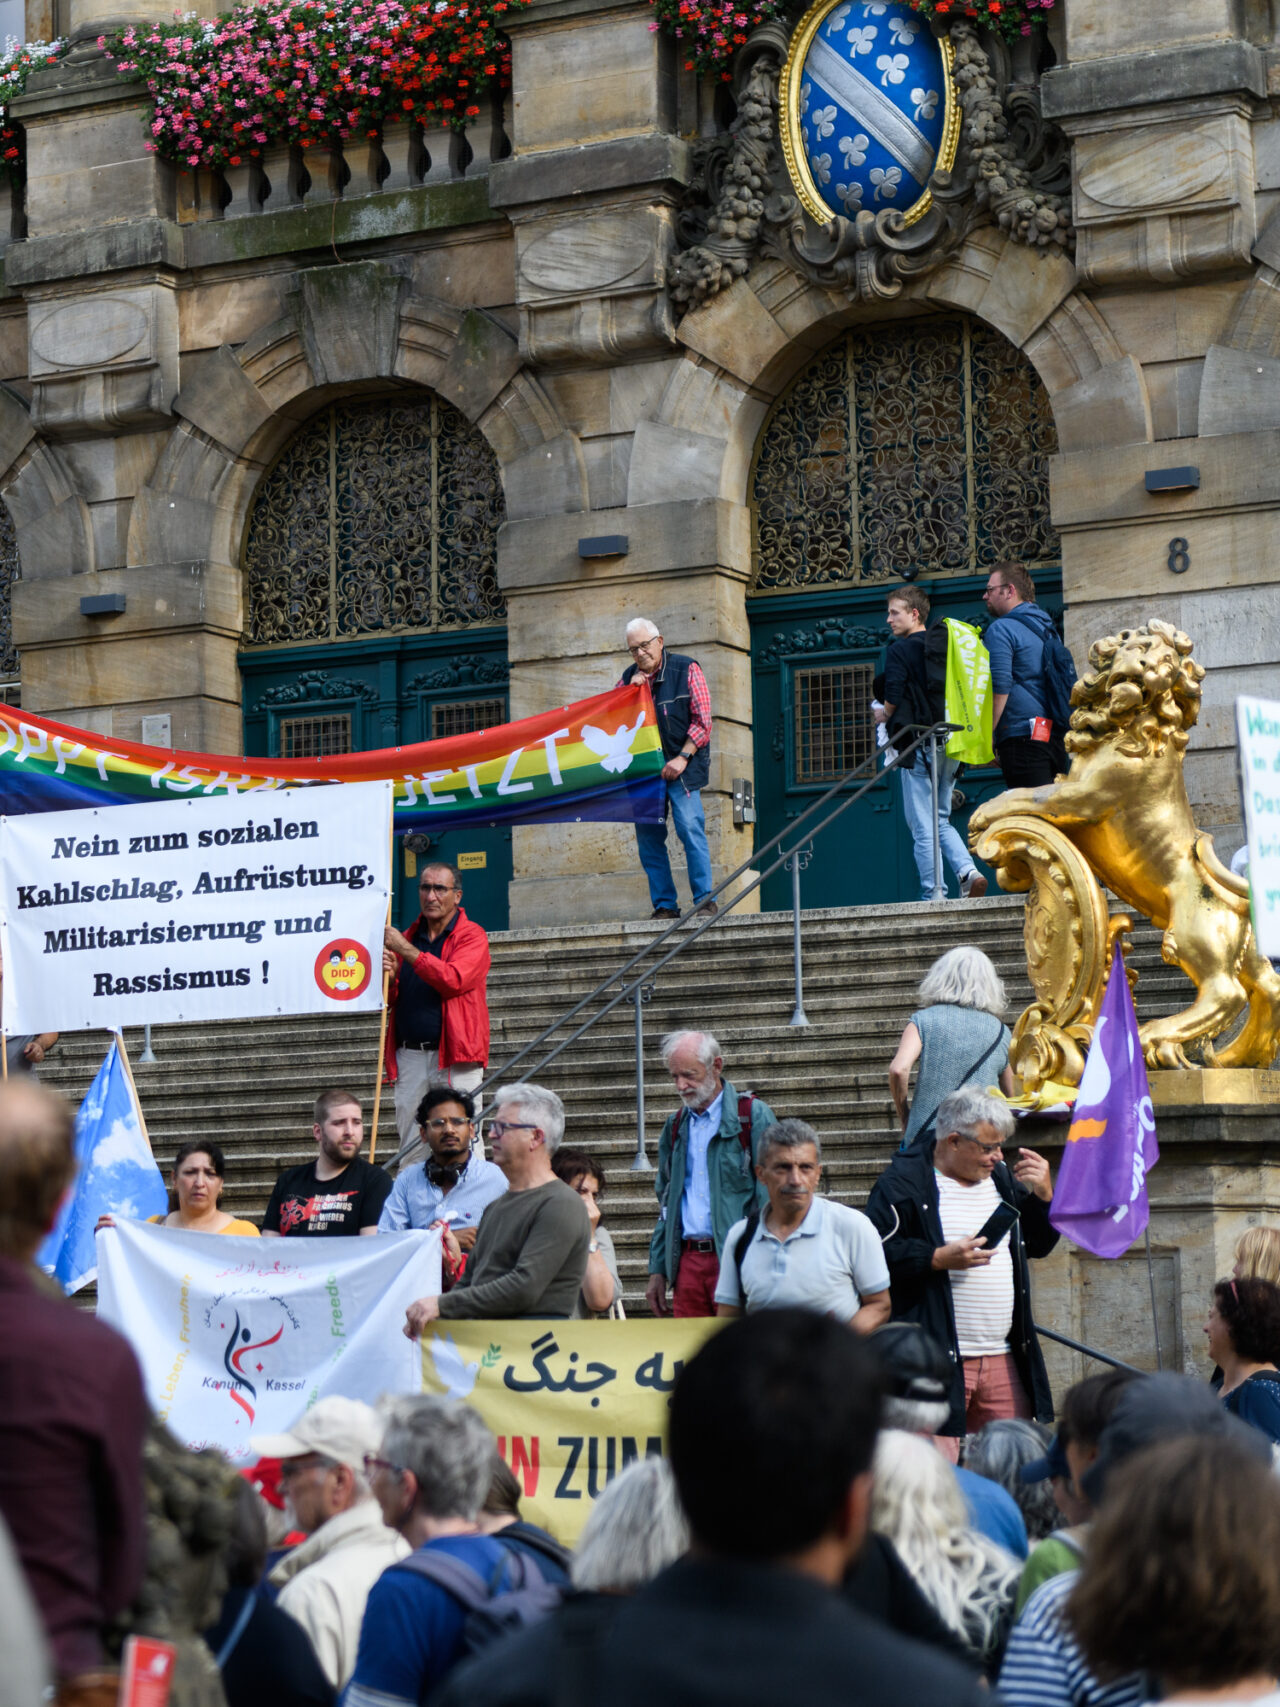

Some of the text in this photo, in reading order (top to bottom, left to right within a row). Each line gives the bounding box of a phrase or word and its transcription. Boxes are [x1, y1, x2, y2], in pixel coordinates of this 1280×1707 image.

[1168, 537, 1190, 574] 8
[151, 760, 343, 796] ISRA
[395, 728, 569, 807] JETZT
[51, 818, 320, 859] Nein zum sozialen
[16, 864, 375, 910] Kahlschlag, Aufrüstung,
[43, 910, 333, 954] Militarisierung und
[93, 965, 251, 997] Rassismus
[330, 967, 356, 979] DIDF
[324, 1270, 347, 1338] Freedo
[201, 1376, 306, 1392] Kanun Kassel
[503, 1331, 617, 1408] جنگ
